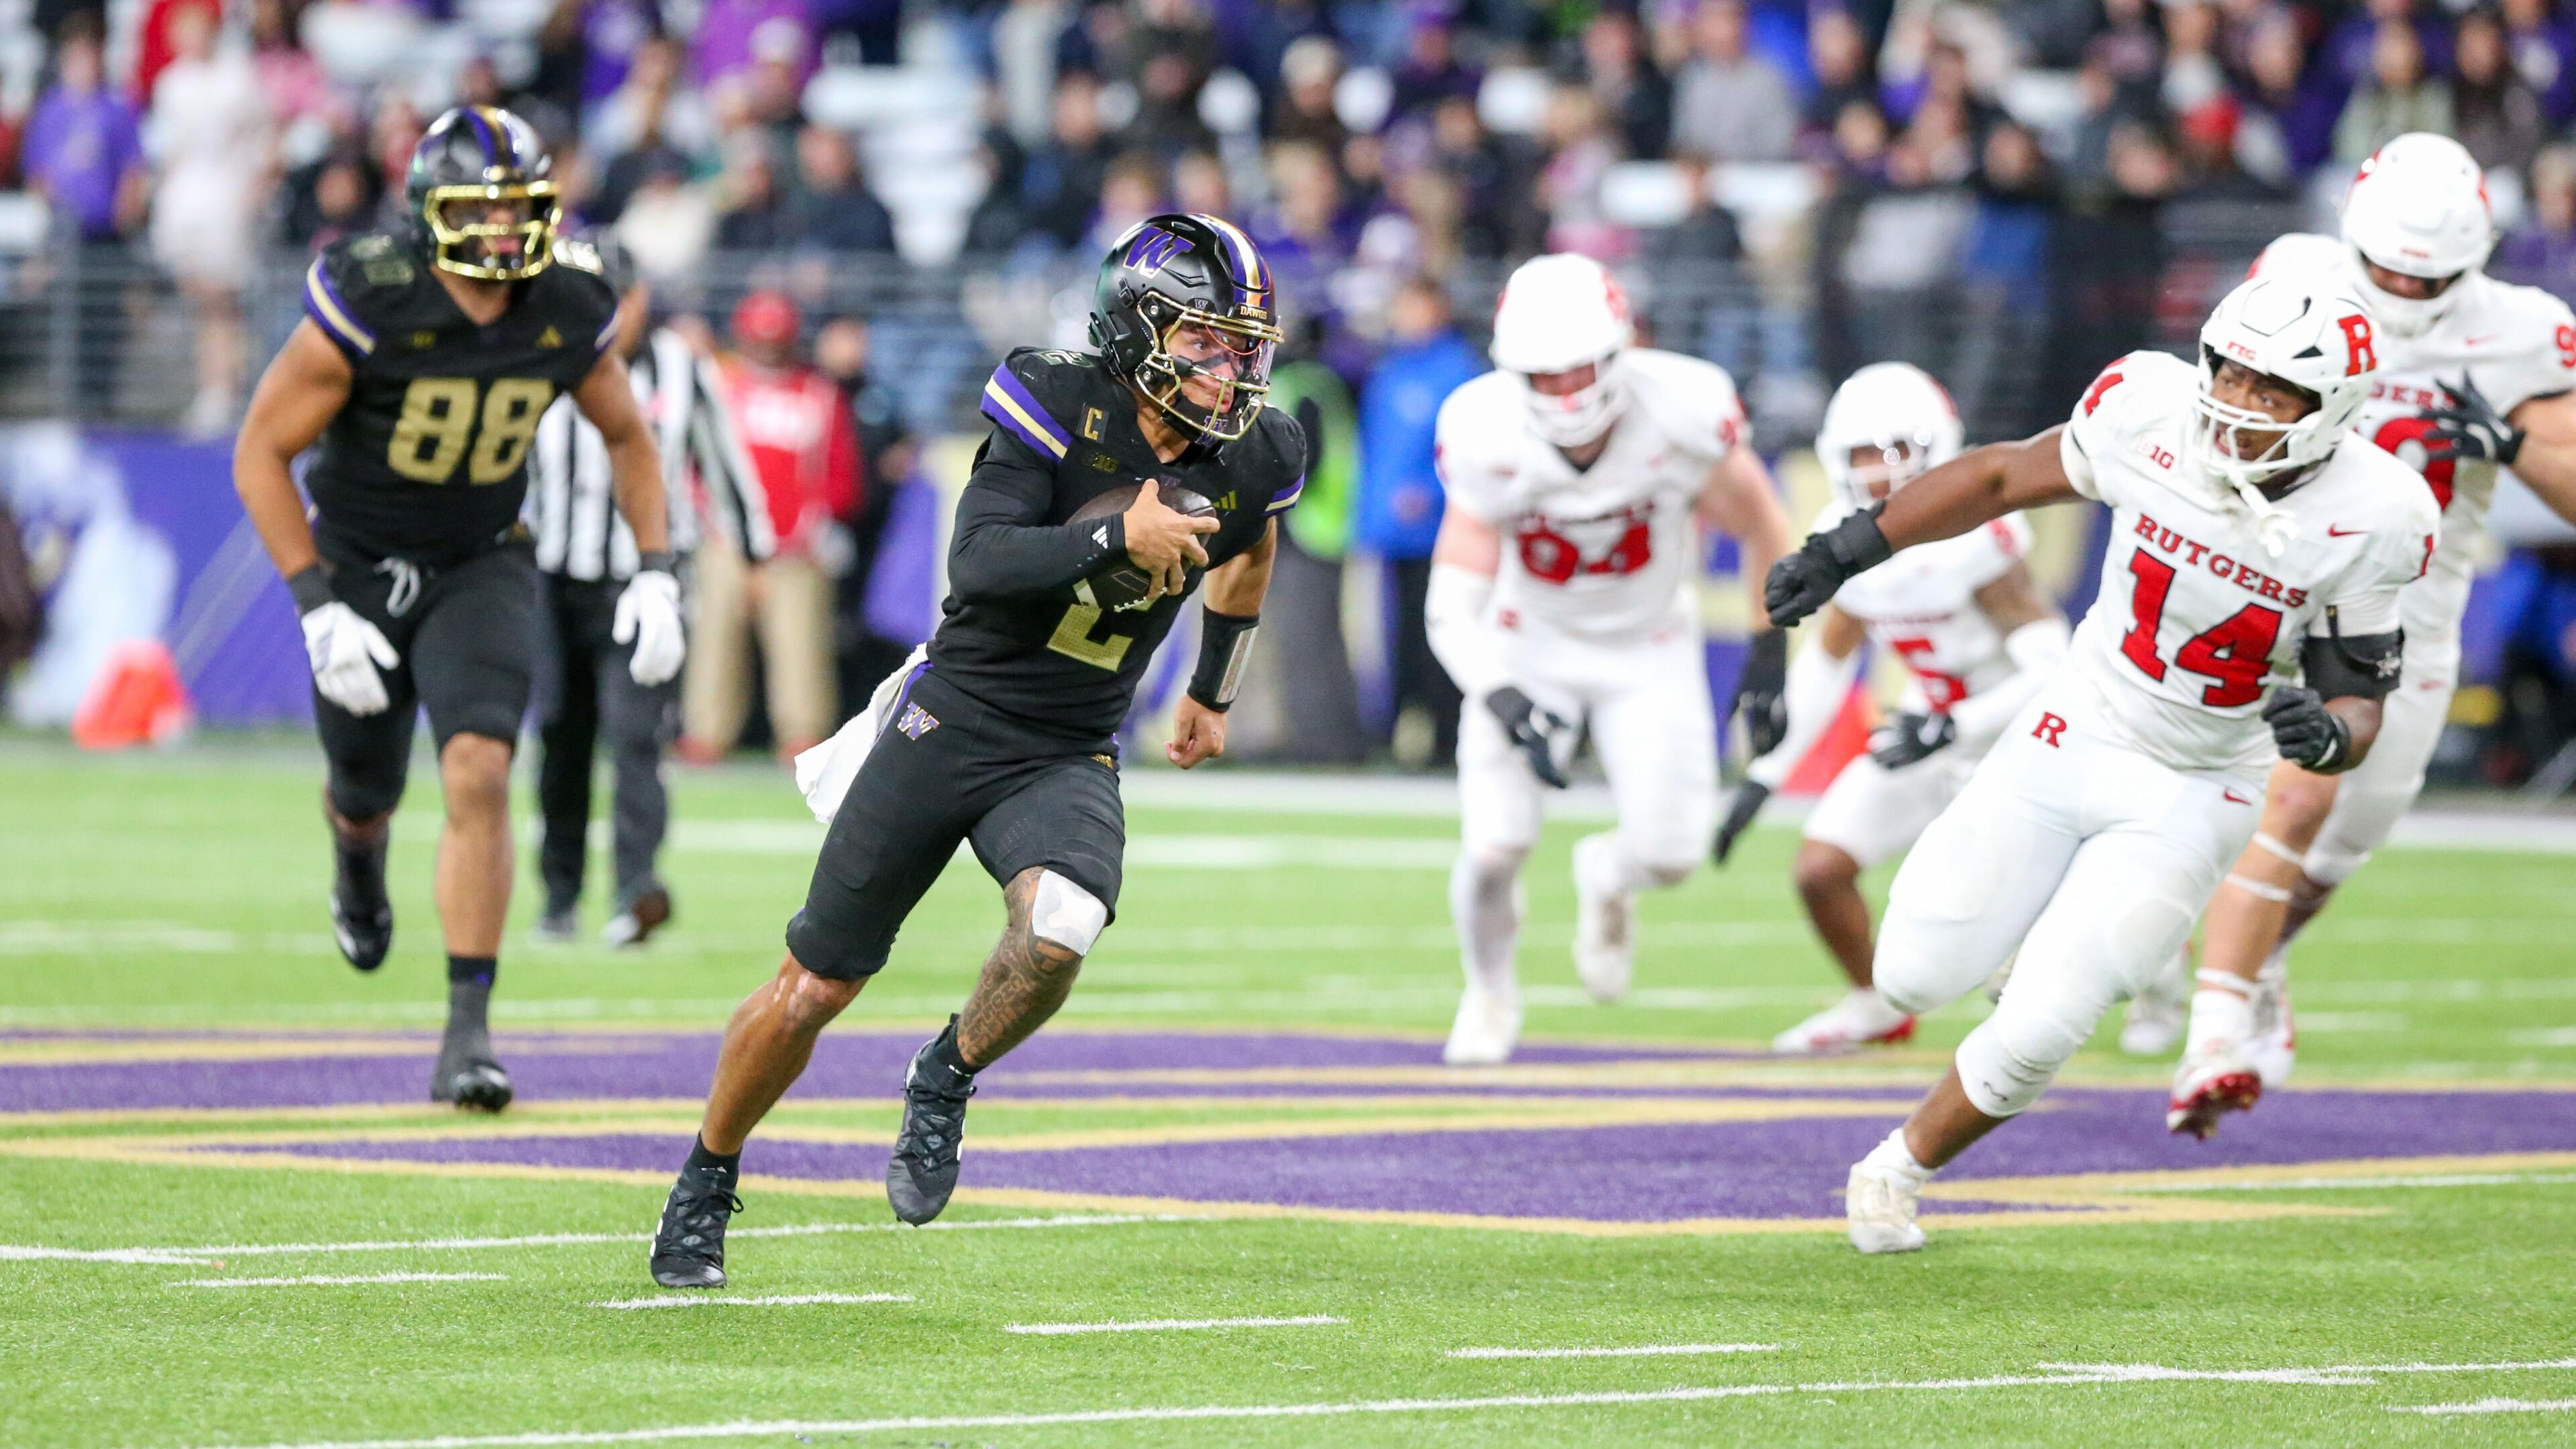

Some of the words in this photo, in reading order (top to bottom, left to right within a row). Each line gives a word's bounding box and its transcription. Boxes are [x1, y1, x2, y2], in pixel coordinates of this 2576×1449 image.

[1123, 225, 1195, 278] W
[1240, 306, 1267, 320] DAWGS
[2337, 315, 2375, 376] R
[387, 376, 553, 485] 88
[1084, 407, 1102, 440] C
[2135, 513, 2308, 608] RUTGERS
[2121, 547, 2284, 708] 14
[897, 701, 940, 741] W
[2031, 711, 2068, 748] R
